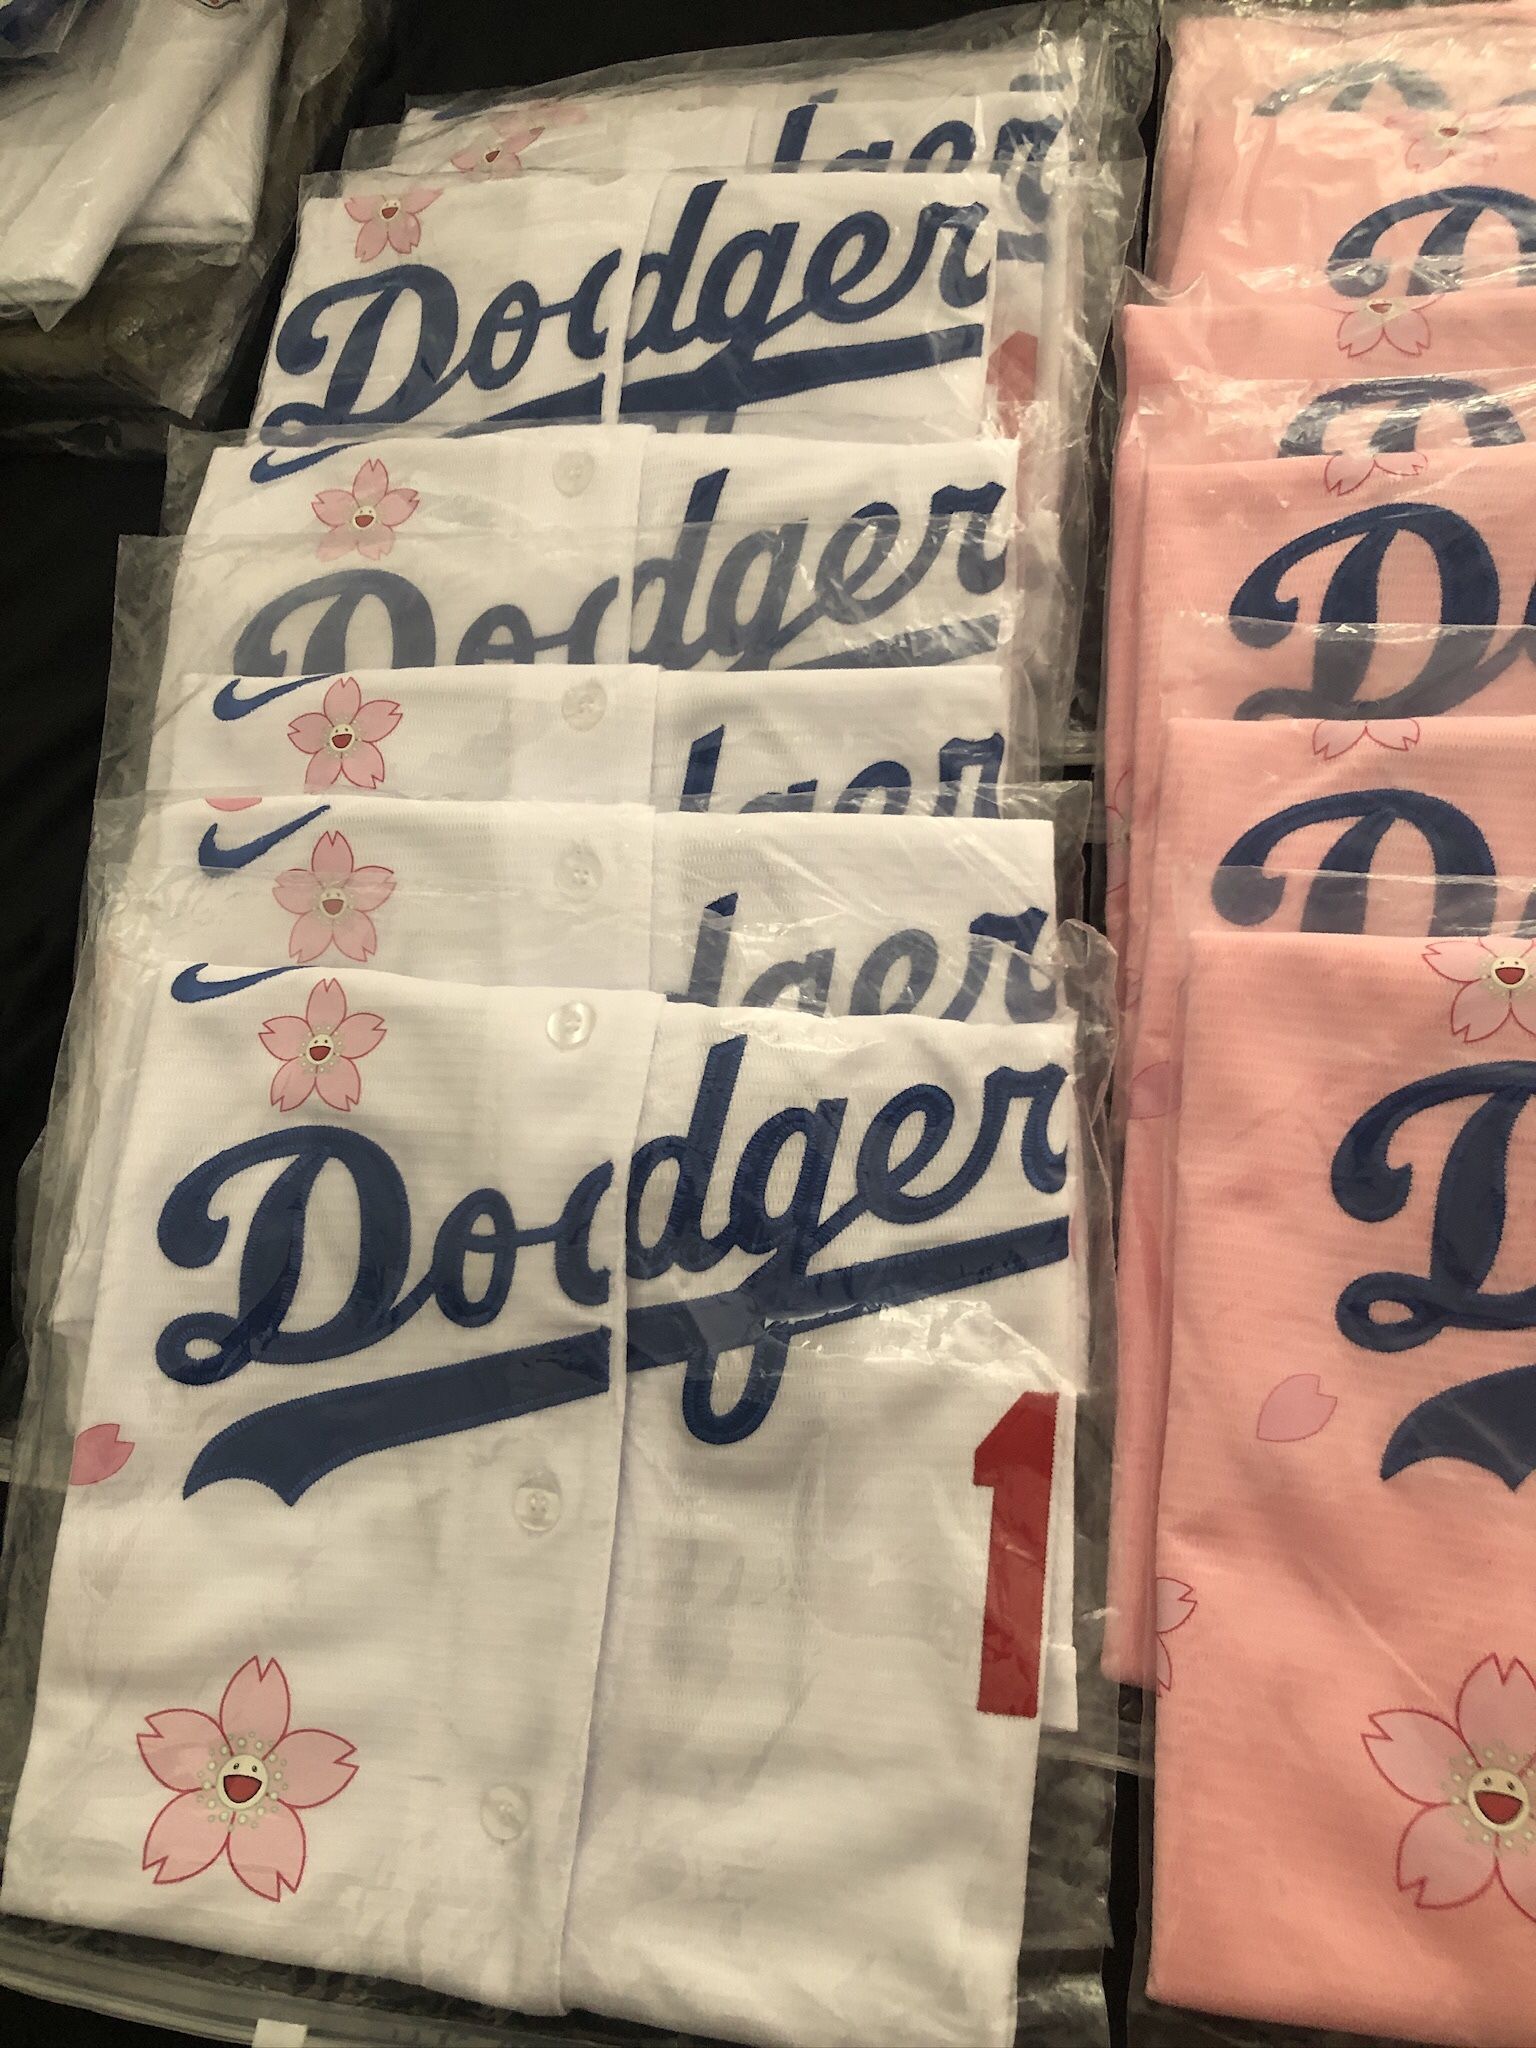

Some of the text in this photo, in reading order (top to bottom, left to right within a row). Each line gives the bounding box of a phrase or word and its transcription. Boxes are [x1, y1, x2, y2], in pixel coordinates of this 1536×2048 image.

[259, 179, 990, 434] Dodger
[156, 1035, 1067, 1444] Dodger
[974, 1392, 1060, 1718] 1
